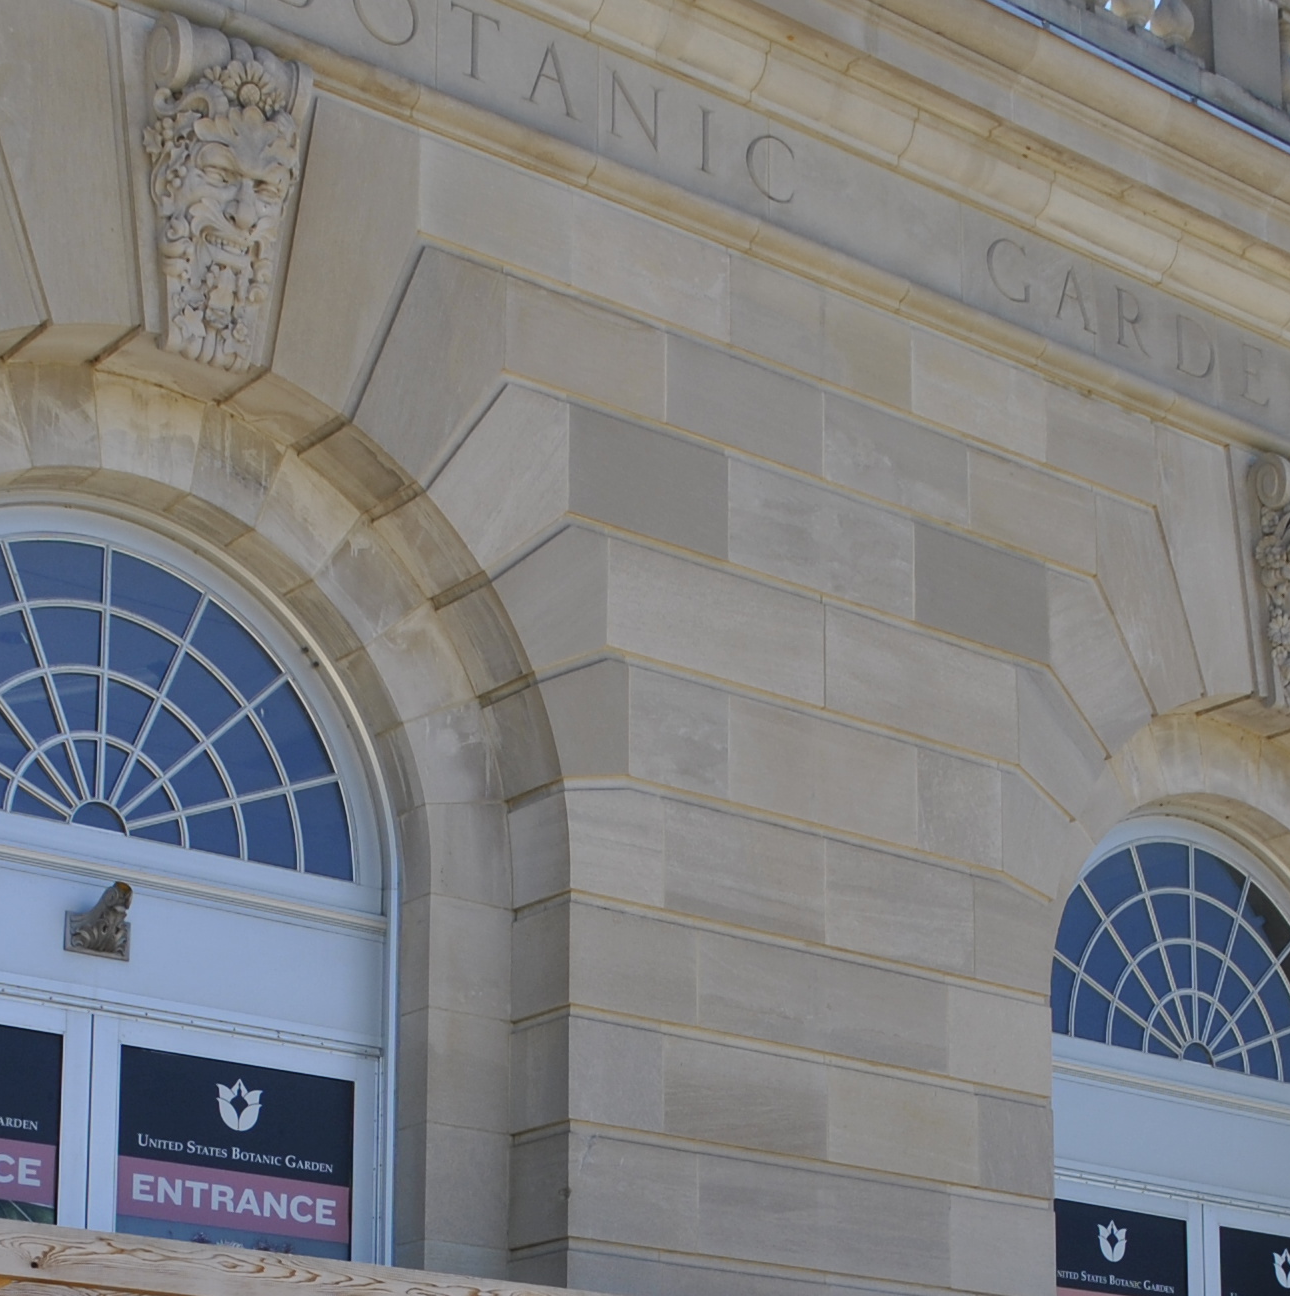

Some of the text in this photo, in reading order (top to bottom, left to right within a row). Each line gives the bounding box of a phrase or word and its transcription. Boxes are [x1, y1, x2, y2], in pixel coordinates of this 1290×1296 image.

[271, 0, 796, 204] OTANIC
[132, 1173, 336, 1226] ENTRANCE
[1056, 1269, 1079, 1280] NITED
